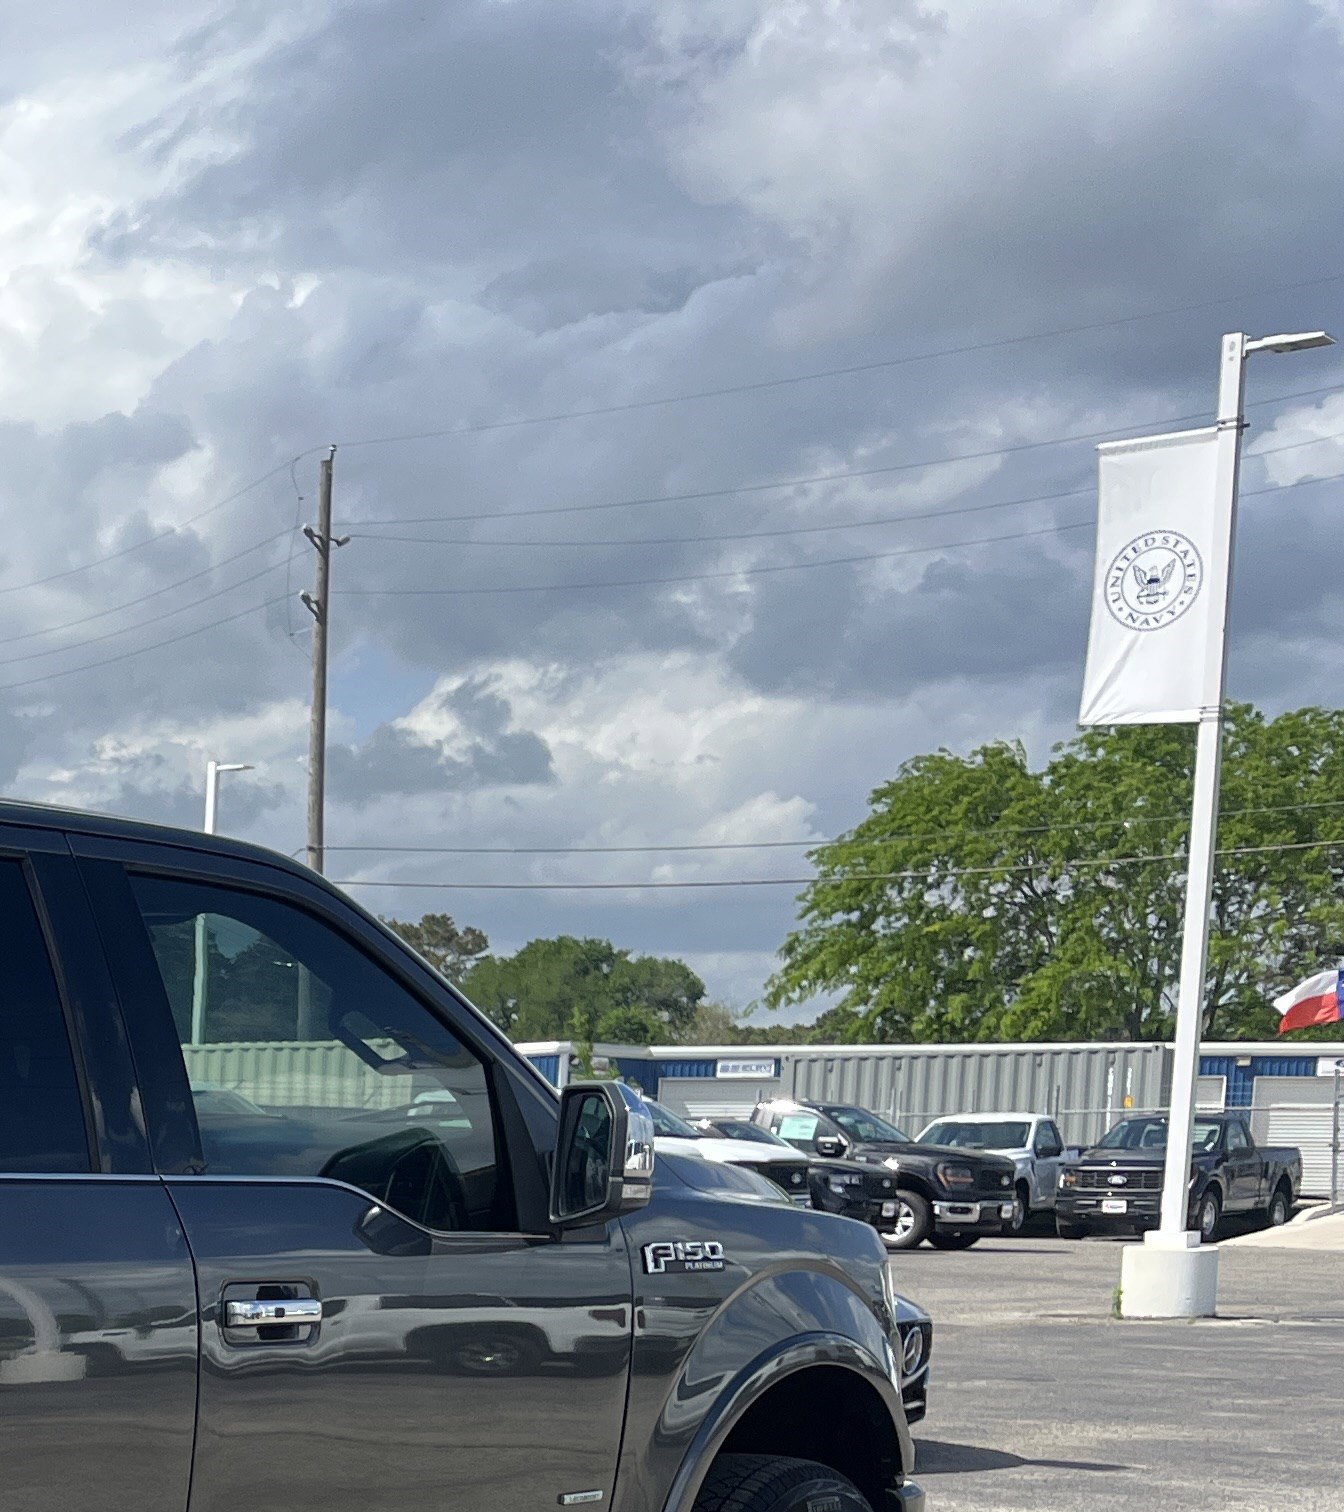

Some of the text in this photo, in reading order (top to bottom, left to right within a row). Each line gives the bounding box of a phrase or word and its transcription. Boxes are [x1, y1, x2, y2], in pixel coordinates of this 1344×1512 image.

[1111, 536, 1196, 603] UNITED STATES
[1125, 608, 1176, 626] NAVY
